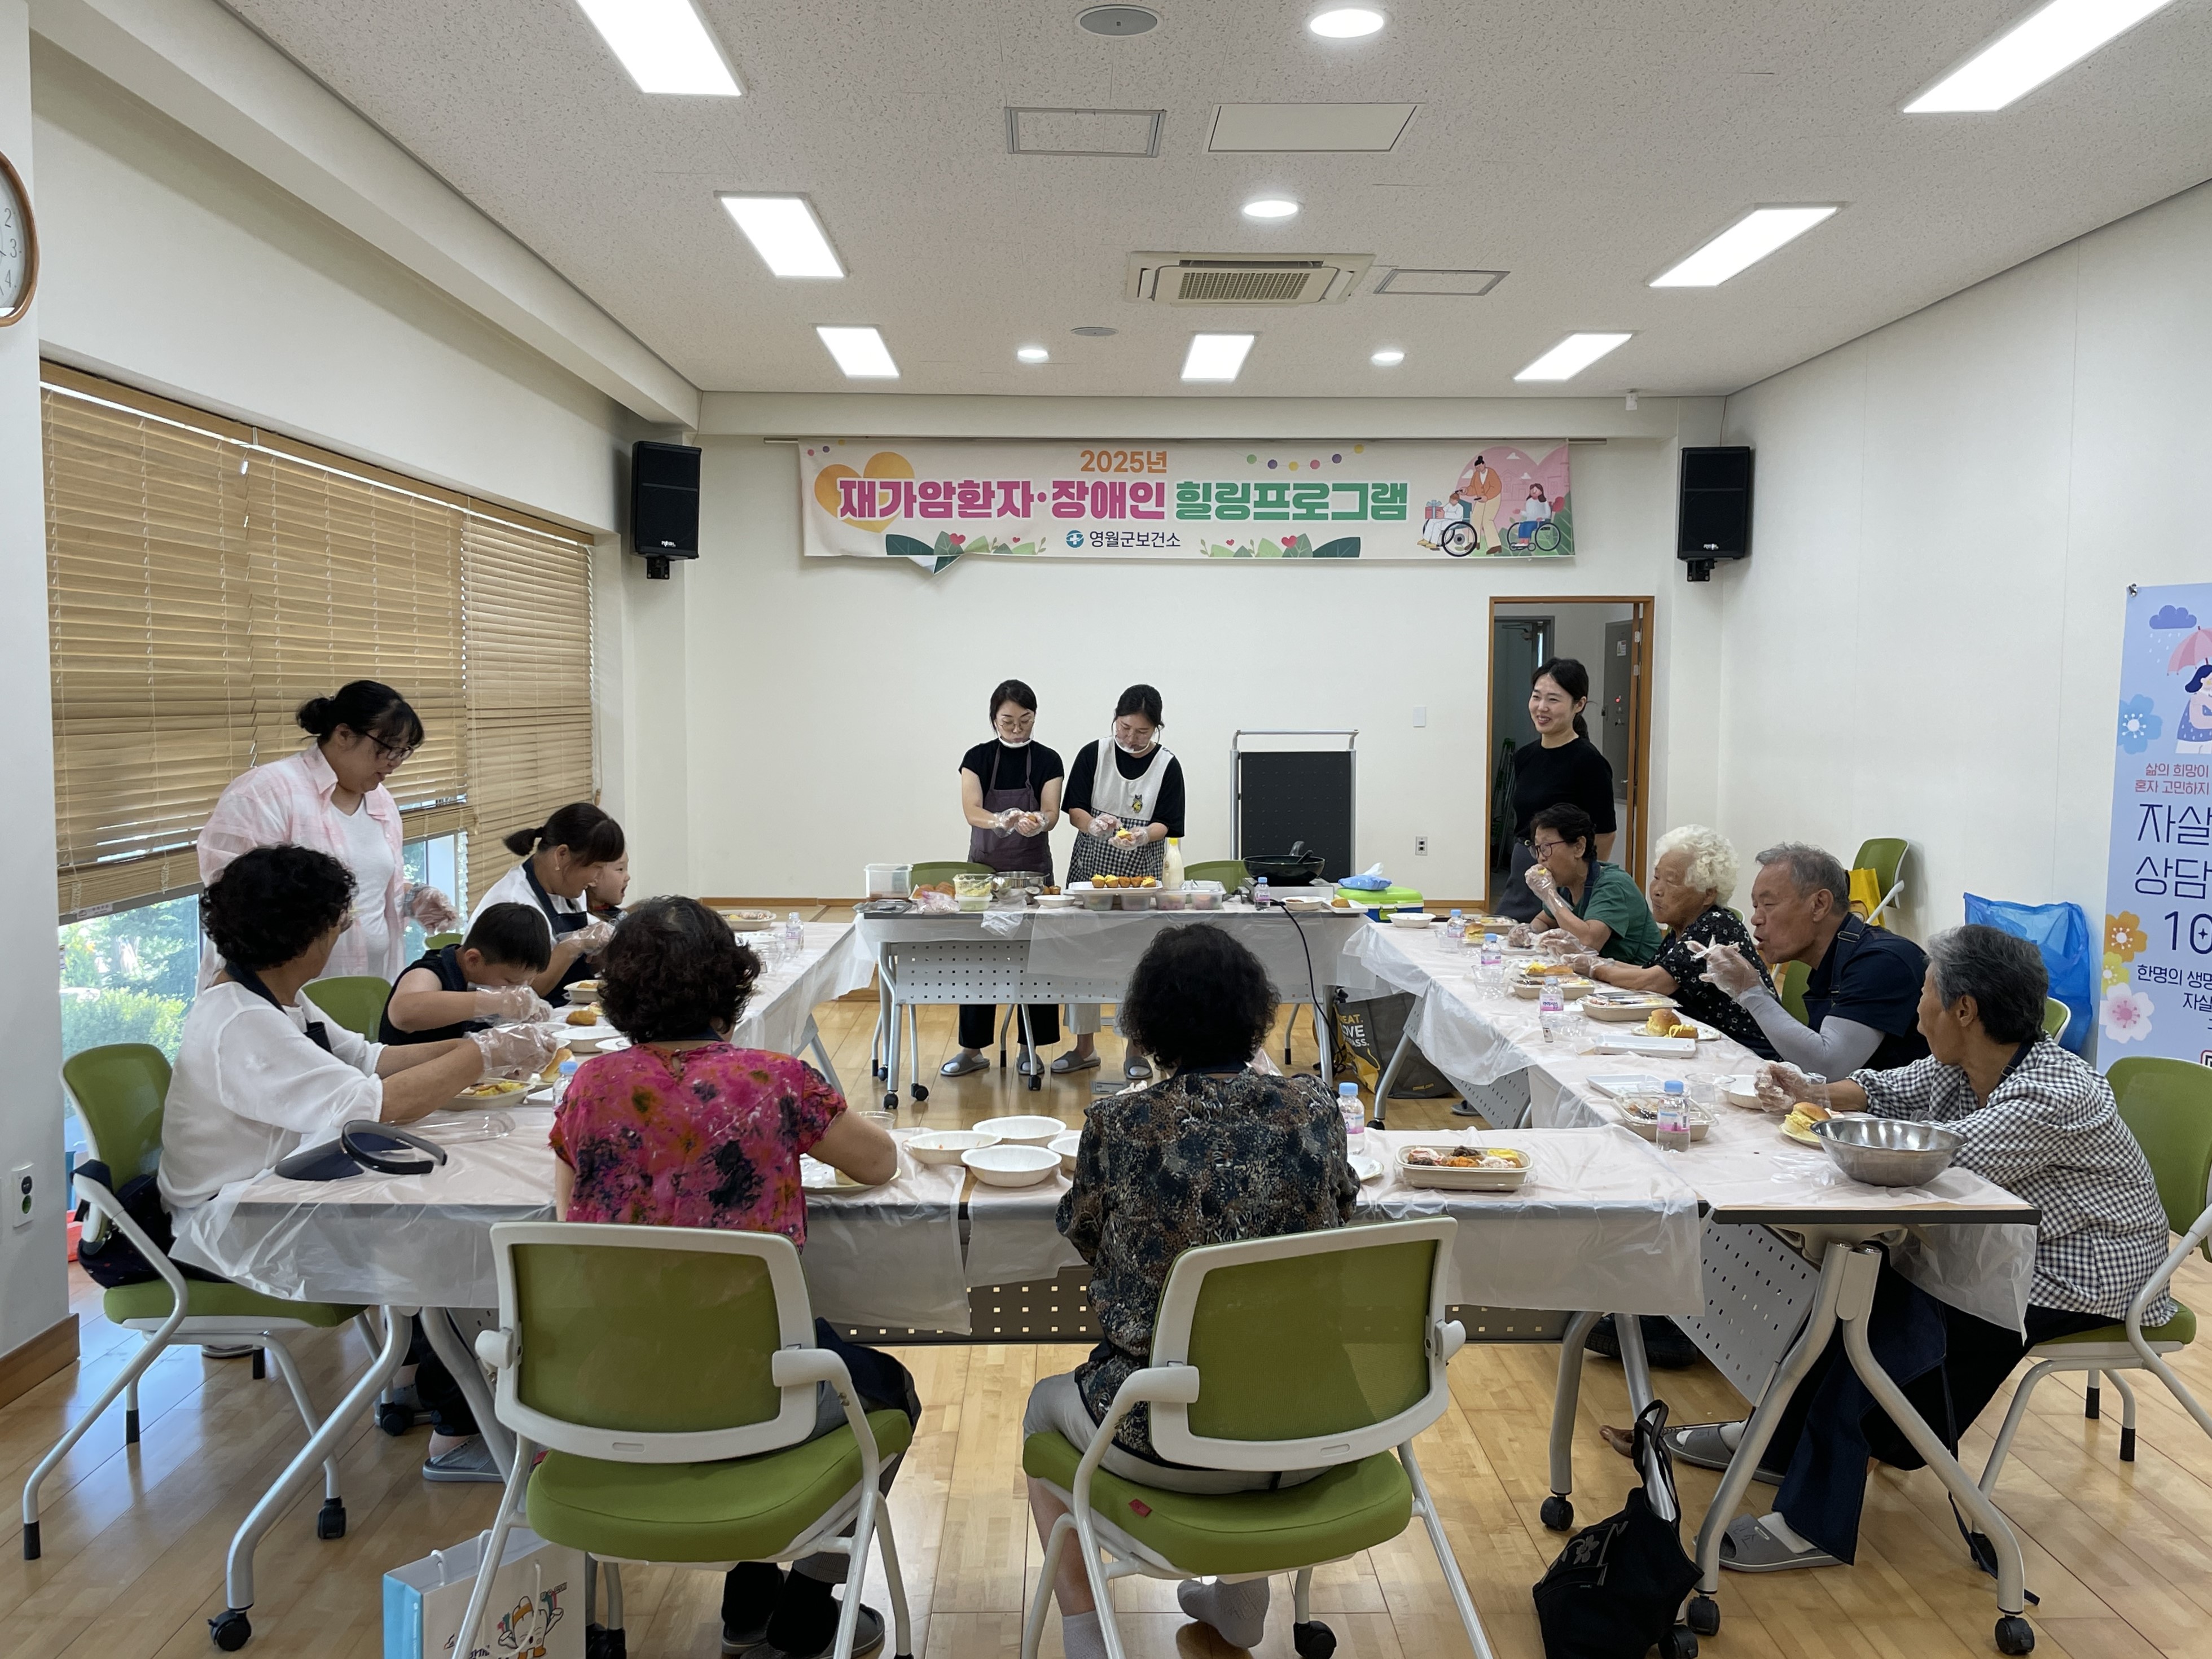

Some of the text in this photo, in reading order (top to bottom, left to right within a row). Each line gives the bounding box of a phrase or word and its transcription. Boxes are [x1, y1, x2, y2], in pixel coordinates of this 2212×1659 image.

[5, 208, 12, 228] 2
[10, 238, 17, 258] 3
[5, 269, 11, 288] 4
[1080, 450, 1167, 473] 2025년
[1175, 481, 1408, 521] 힐링프로그램
[1089, 531, 1181, 547] 영월군보건소
[2145, 763, 2209, 778] 삶의 희망이
[2135, 779, 2210, 796] 혼자 고민하지
[2138, 804, 2212, 846] 자살
[2135, 856, 2212, 899] 상담
[2137, 964, 2183, 986] 한명의
